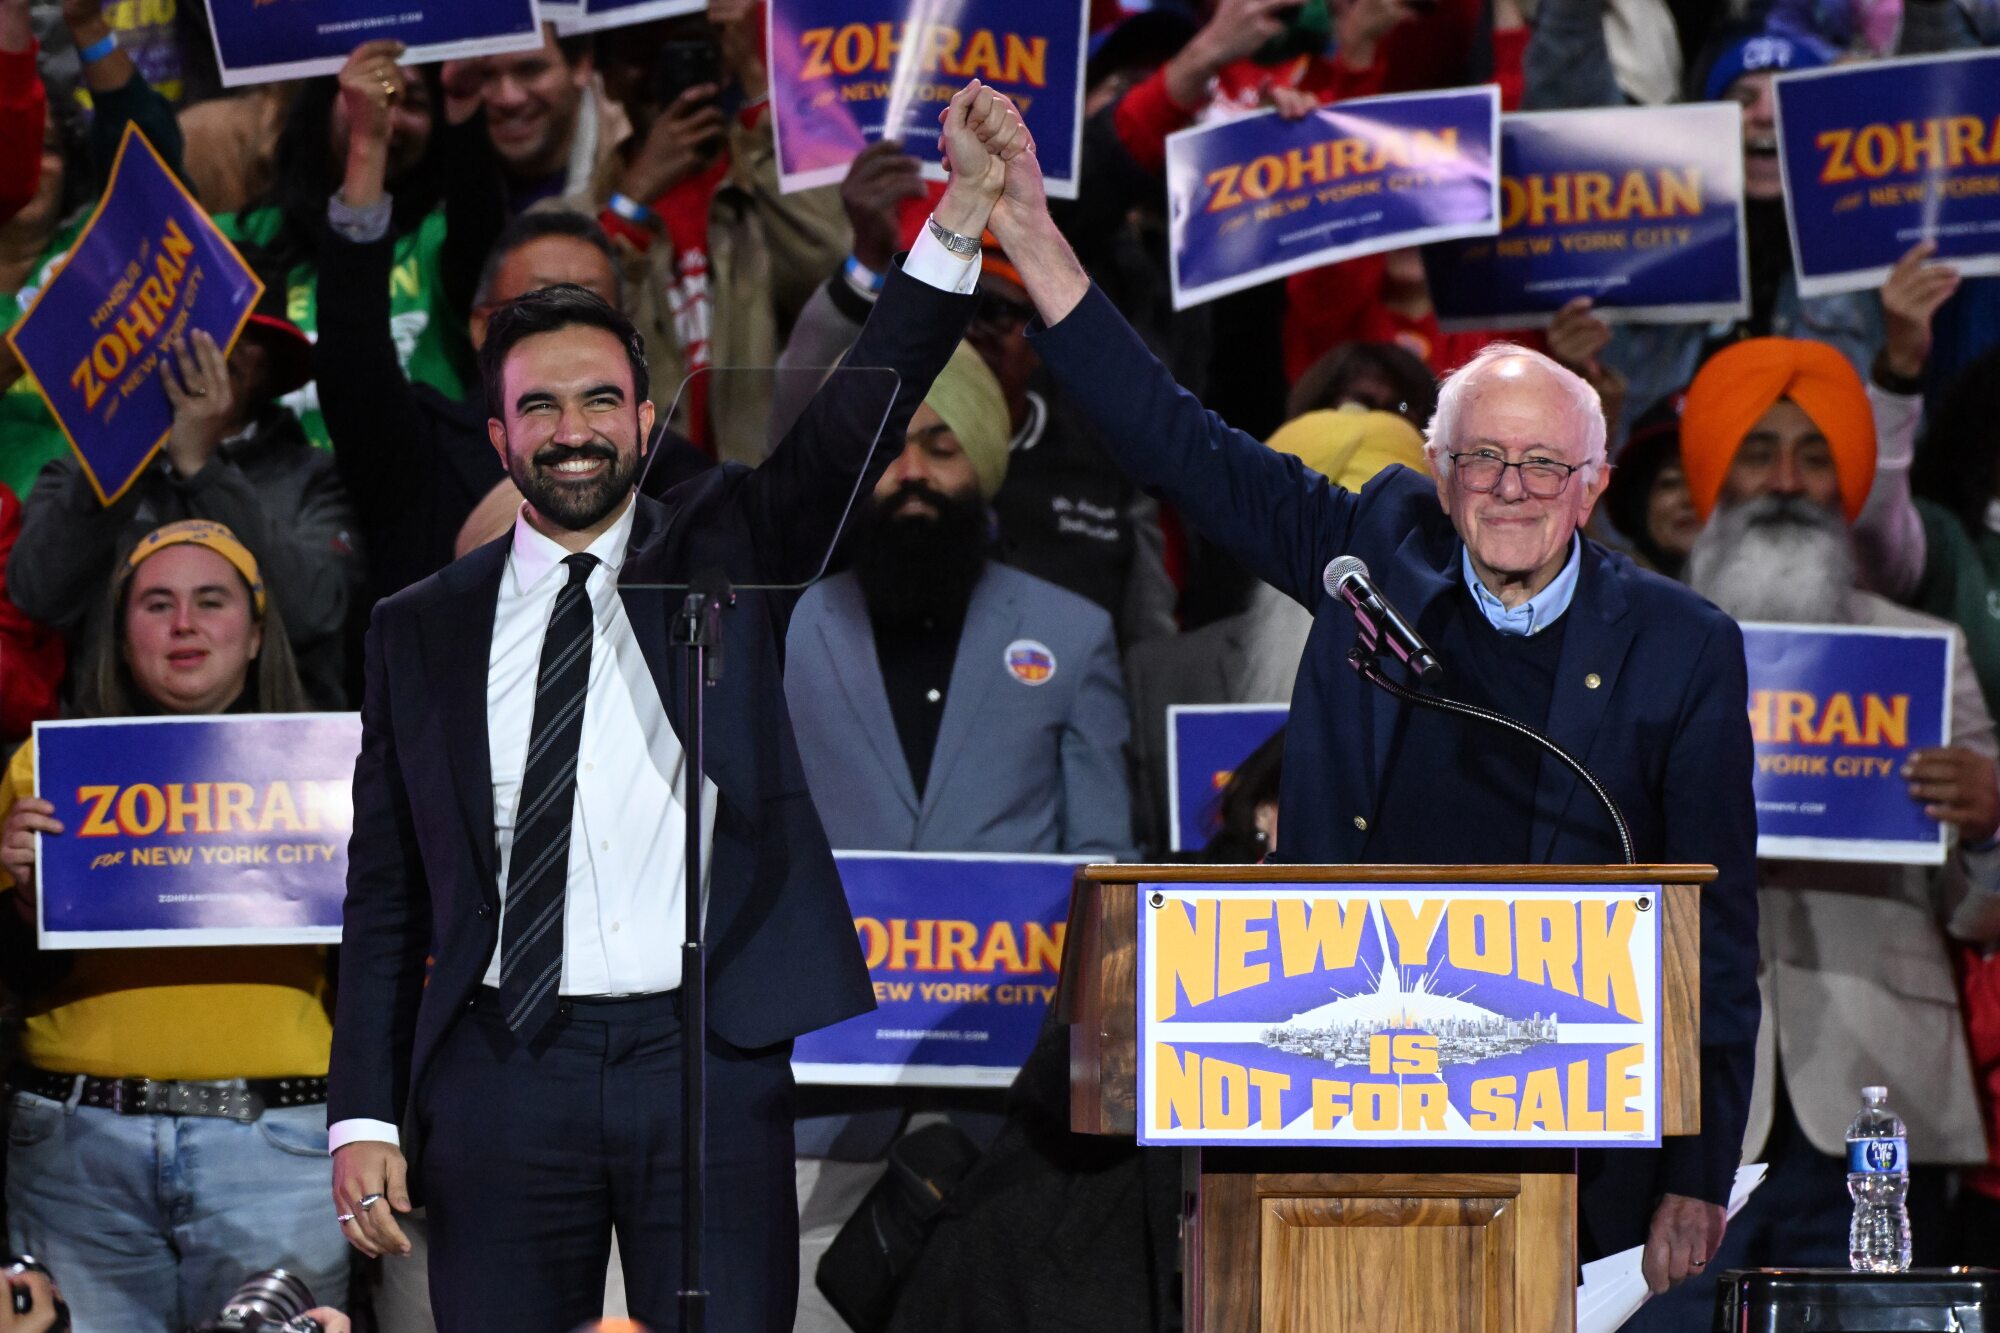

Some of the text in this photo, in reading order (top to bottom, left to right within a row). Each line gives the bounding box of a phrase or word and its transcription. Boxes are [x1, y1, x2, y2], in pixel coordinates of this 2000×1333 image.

[800, 22, 1048, 89] ZOHRAN
[1205, 126, 1459, 214] ZOHRAN
[1254, 196, 1312, 222] NEW
[1316, 178, 1382, 204] YORK
[1500, 166, 1705, 231] OHRAN
[1558, 230, 1627, 252] YORK
[1632, 226, 1693, 249] CITY
[70, 215, 196, 414] ZOHRAN
[120, 352, 158, 397] NEW
[1757, 753, 1894, 778] YORK CITY
[90, 843, 337, 870] FOR NEW YORK CITY
[852, 916, 1067, 974] OHRAN
[1155, 898, 1645, 1025] NEW YORK
[872, 981, 1057, 1006] EW YORK CITY
[1369, 1033, 1440, 1075] IS
[1155, 1042, 1645, 1132] NOT FOR SALE
[1871, 1141, 1893, 1152] Pure
[1874, 1150, 1892, 1162] Life
